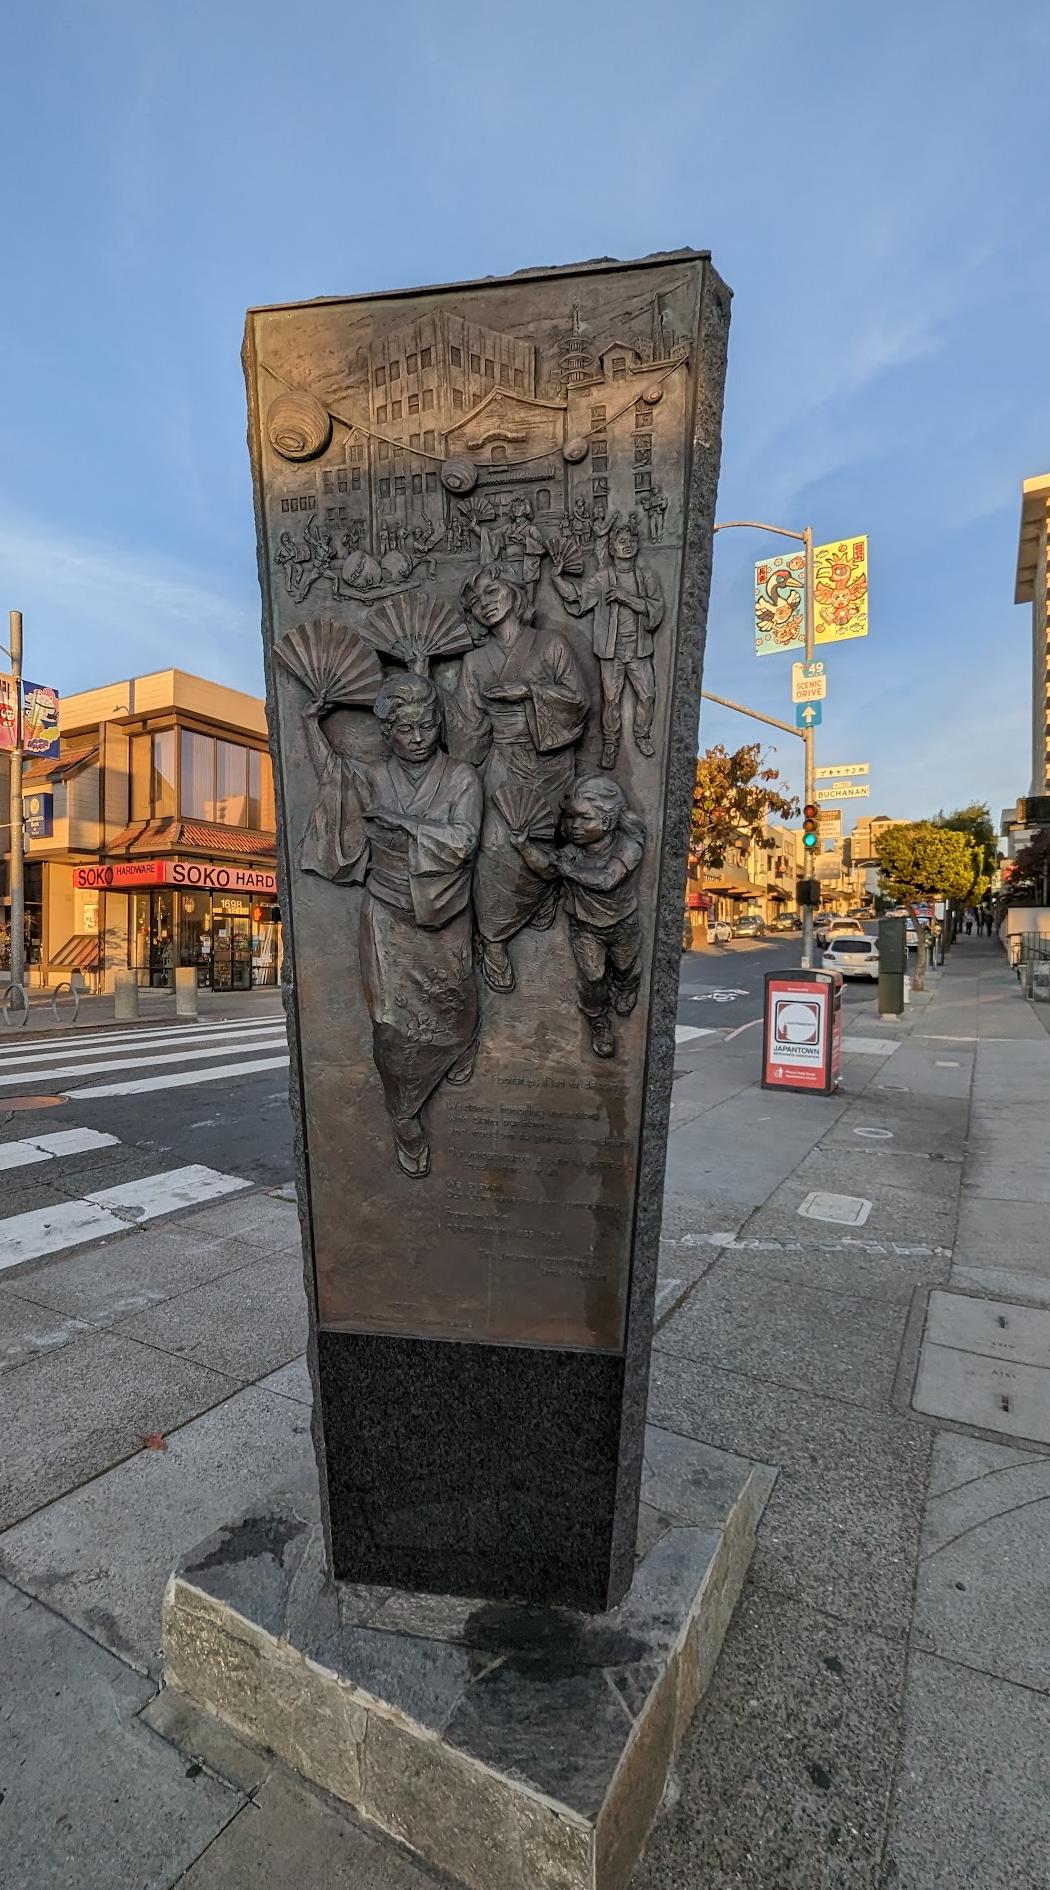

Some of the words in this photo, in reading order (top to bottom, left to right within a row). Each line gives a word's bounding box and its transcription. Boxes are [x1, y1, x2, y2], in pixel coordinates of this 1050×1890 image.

[808, 662, 824, 673] 49
[796, 680, 822, 690] SCENIC
[796, 688, 822, 698] DRIVE
[818, 788, 867, 799] BUCHANAN
[78, 867, 114, 886] SOKO
[116, 863, 156, 876] HARDWARE
[173, 864, 230, 887] SOKO
[236, 872, 278, 888] HARD
[221, 899, 243, 909] 1698
[773, 1045, 820, 1055] JAPANTOWN
